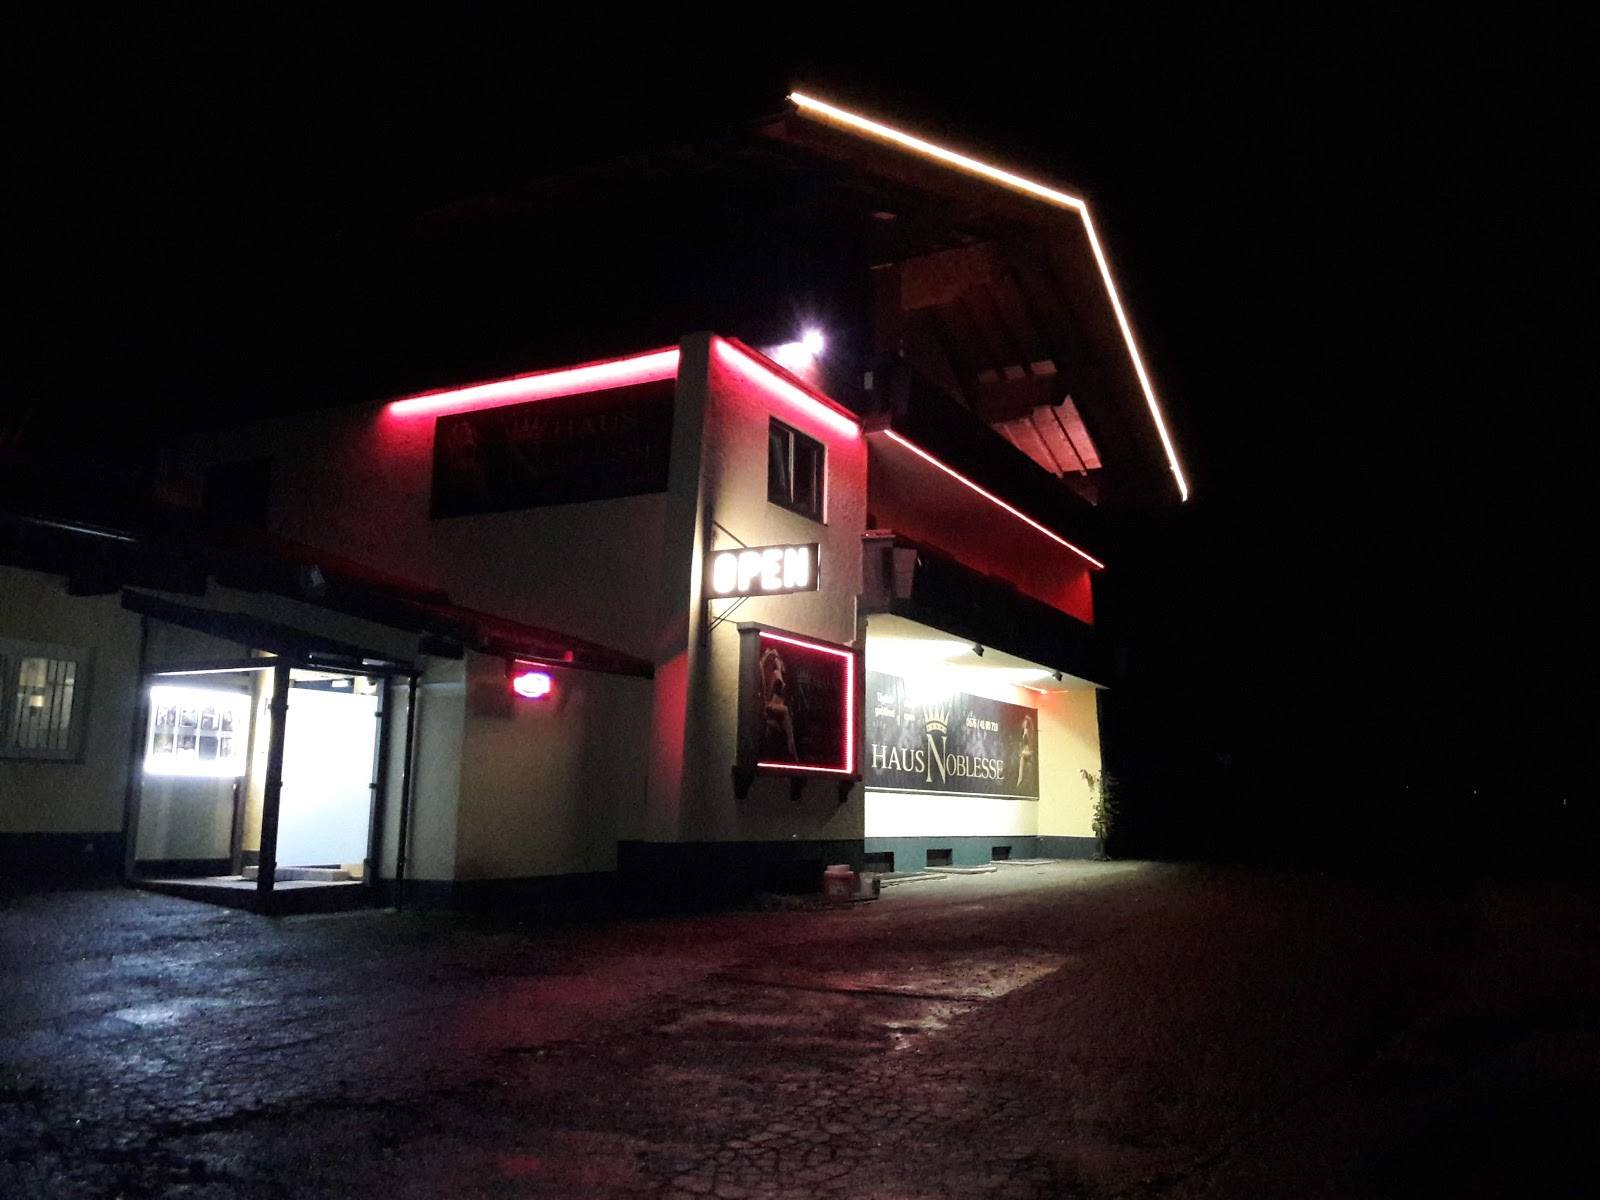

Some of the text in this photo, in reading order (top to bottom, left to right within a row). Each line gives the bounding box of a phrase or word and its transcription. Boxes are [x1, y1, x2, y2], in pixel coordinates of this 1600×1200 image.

[713, 546, 810, 594] OPEN
[871, 733, 1005, 784] HAUS NOBLESSE
